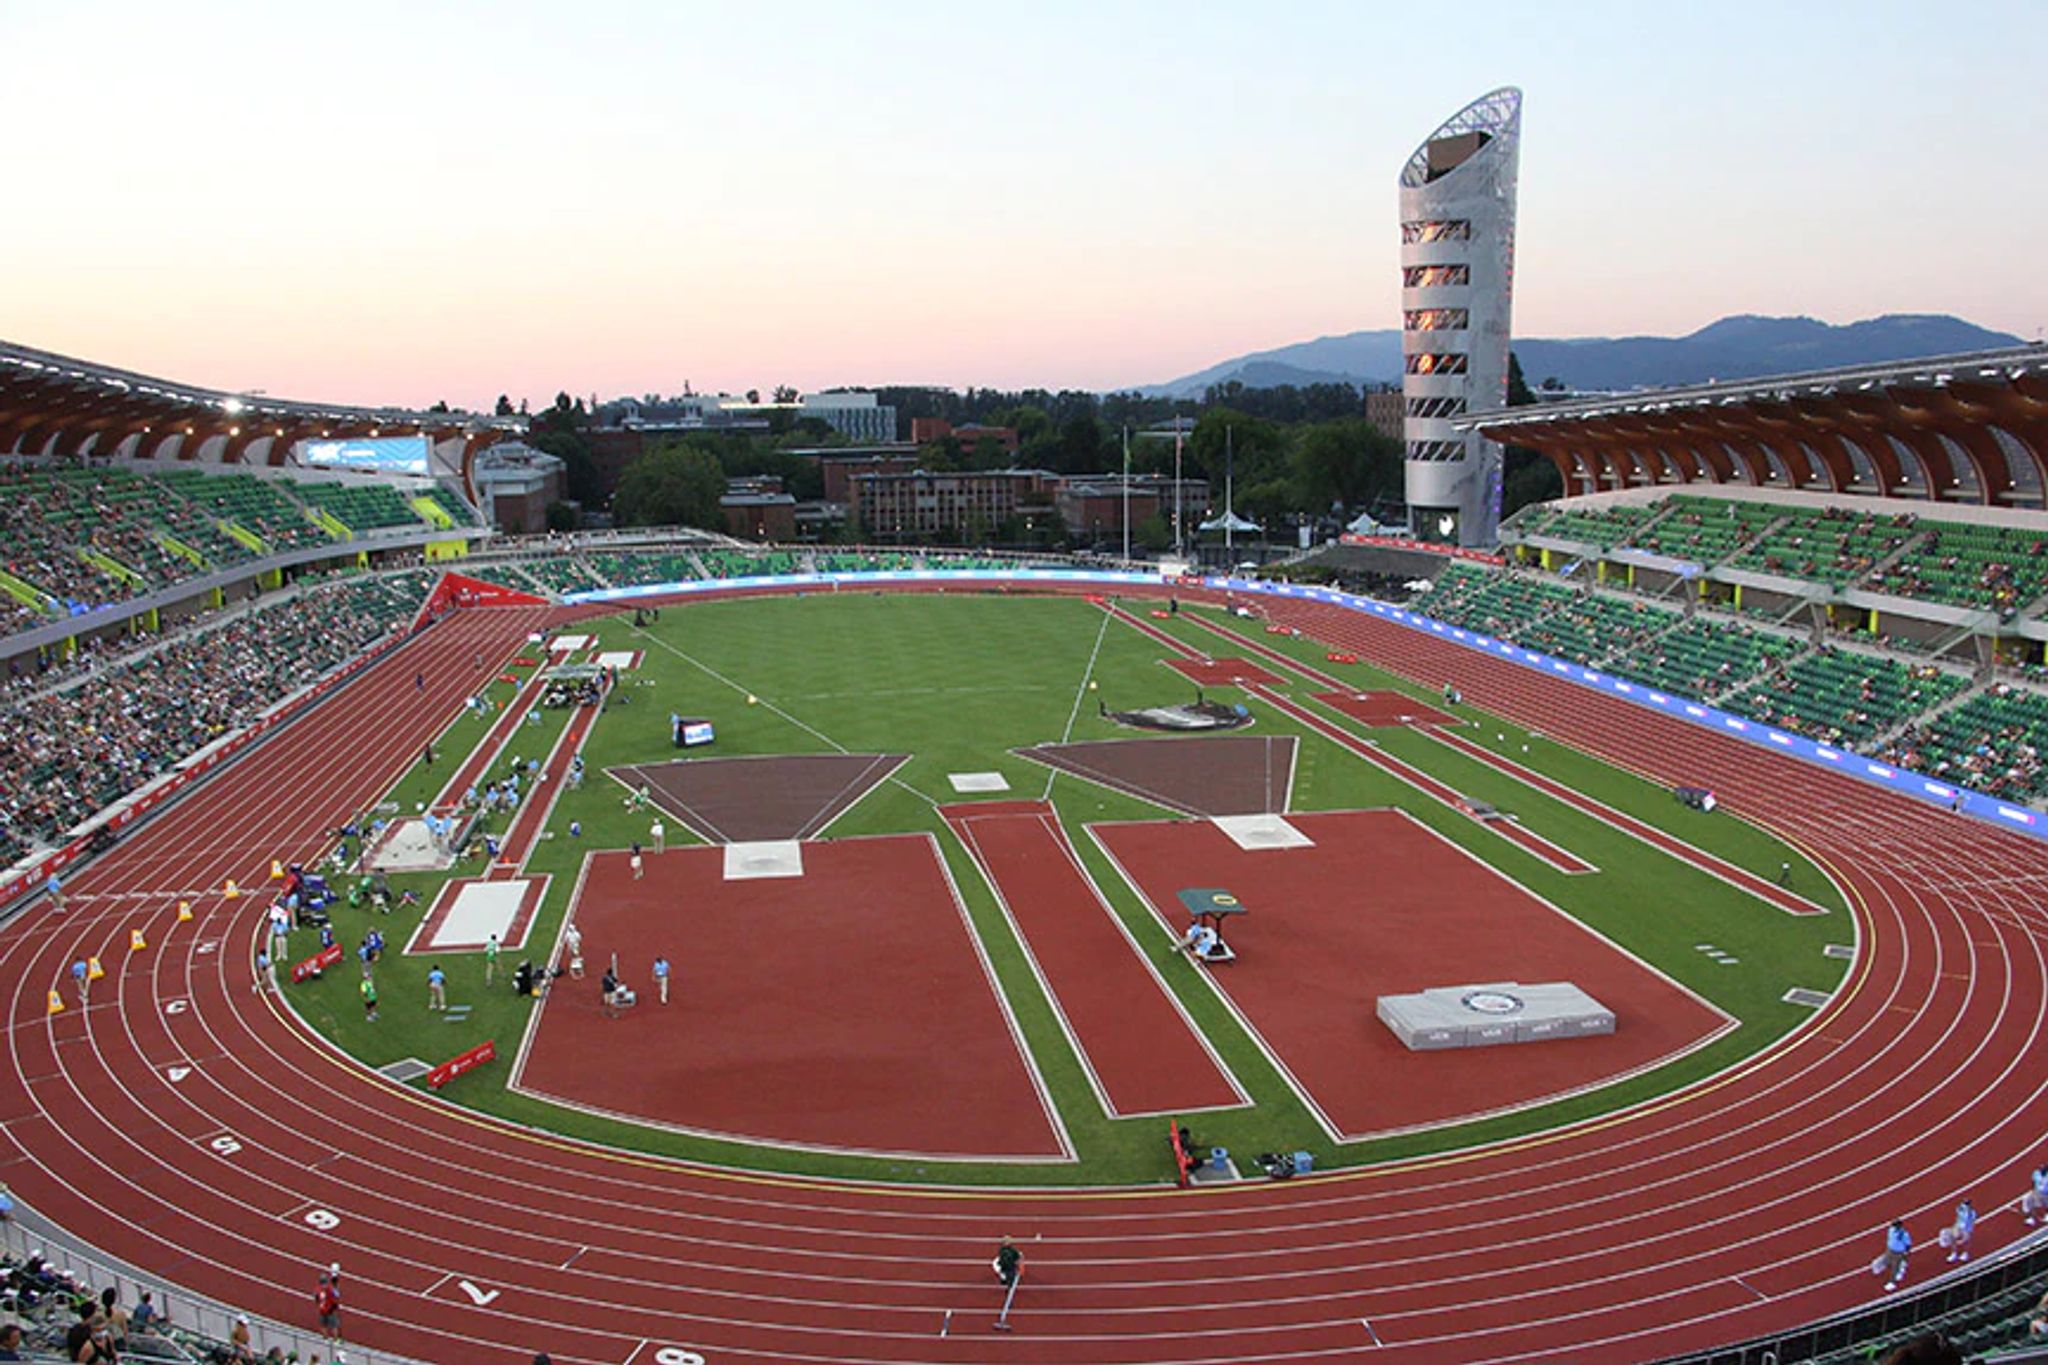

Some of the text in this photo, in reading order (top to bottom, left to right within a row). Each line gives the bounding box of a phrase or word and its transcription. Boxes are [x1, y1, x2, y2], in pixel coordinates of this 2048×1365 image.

[167, 1066, 193, 1083] 4
[210, 1135, 243, 1156] 5
[304, 1209, 342, 1231] 6
[458, 1279, 500, 1305] 7
